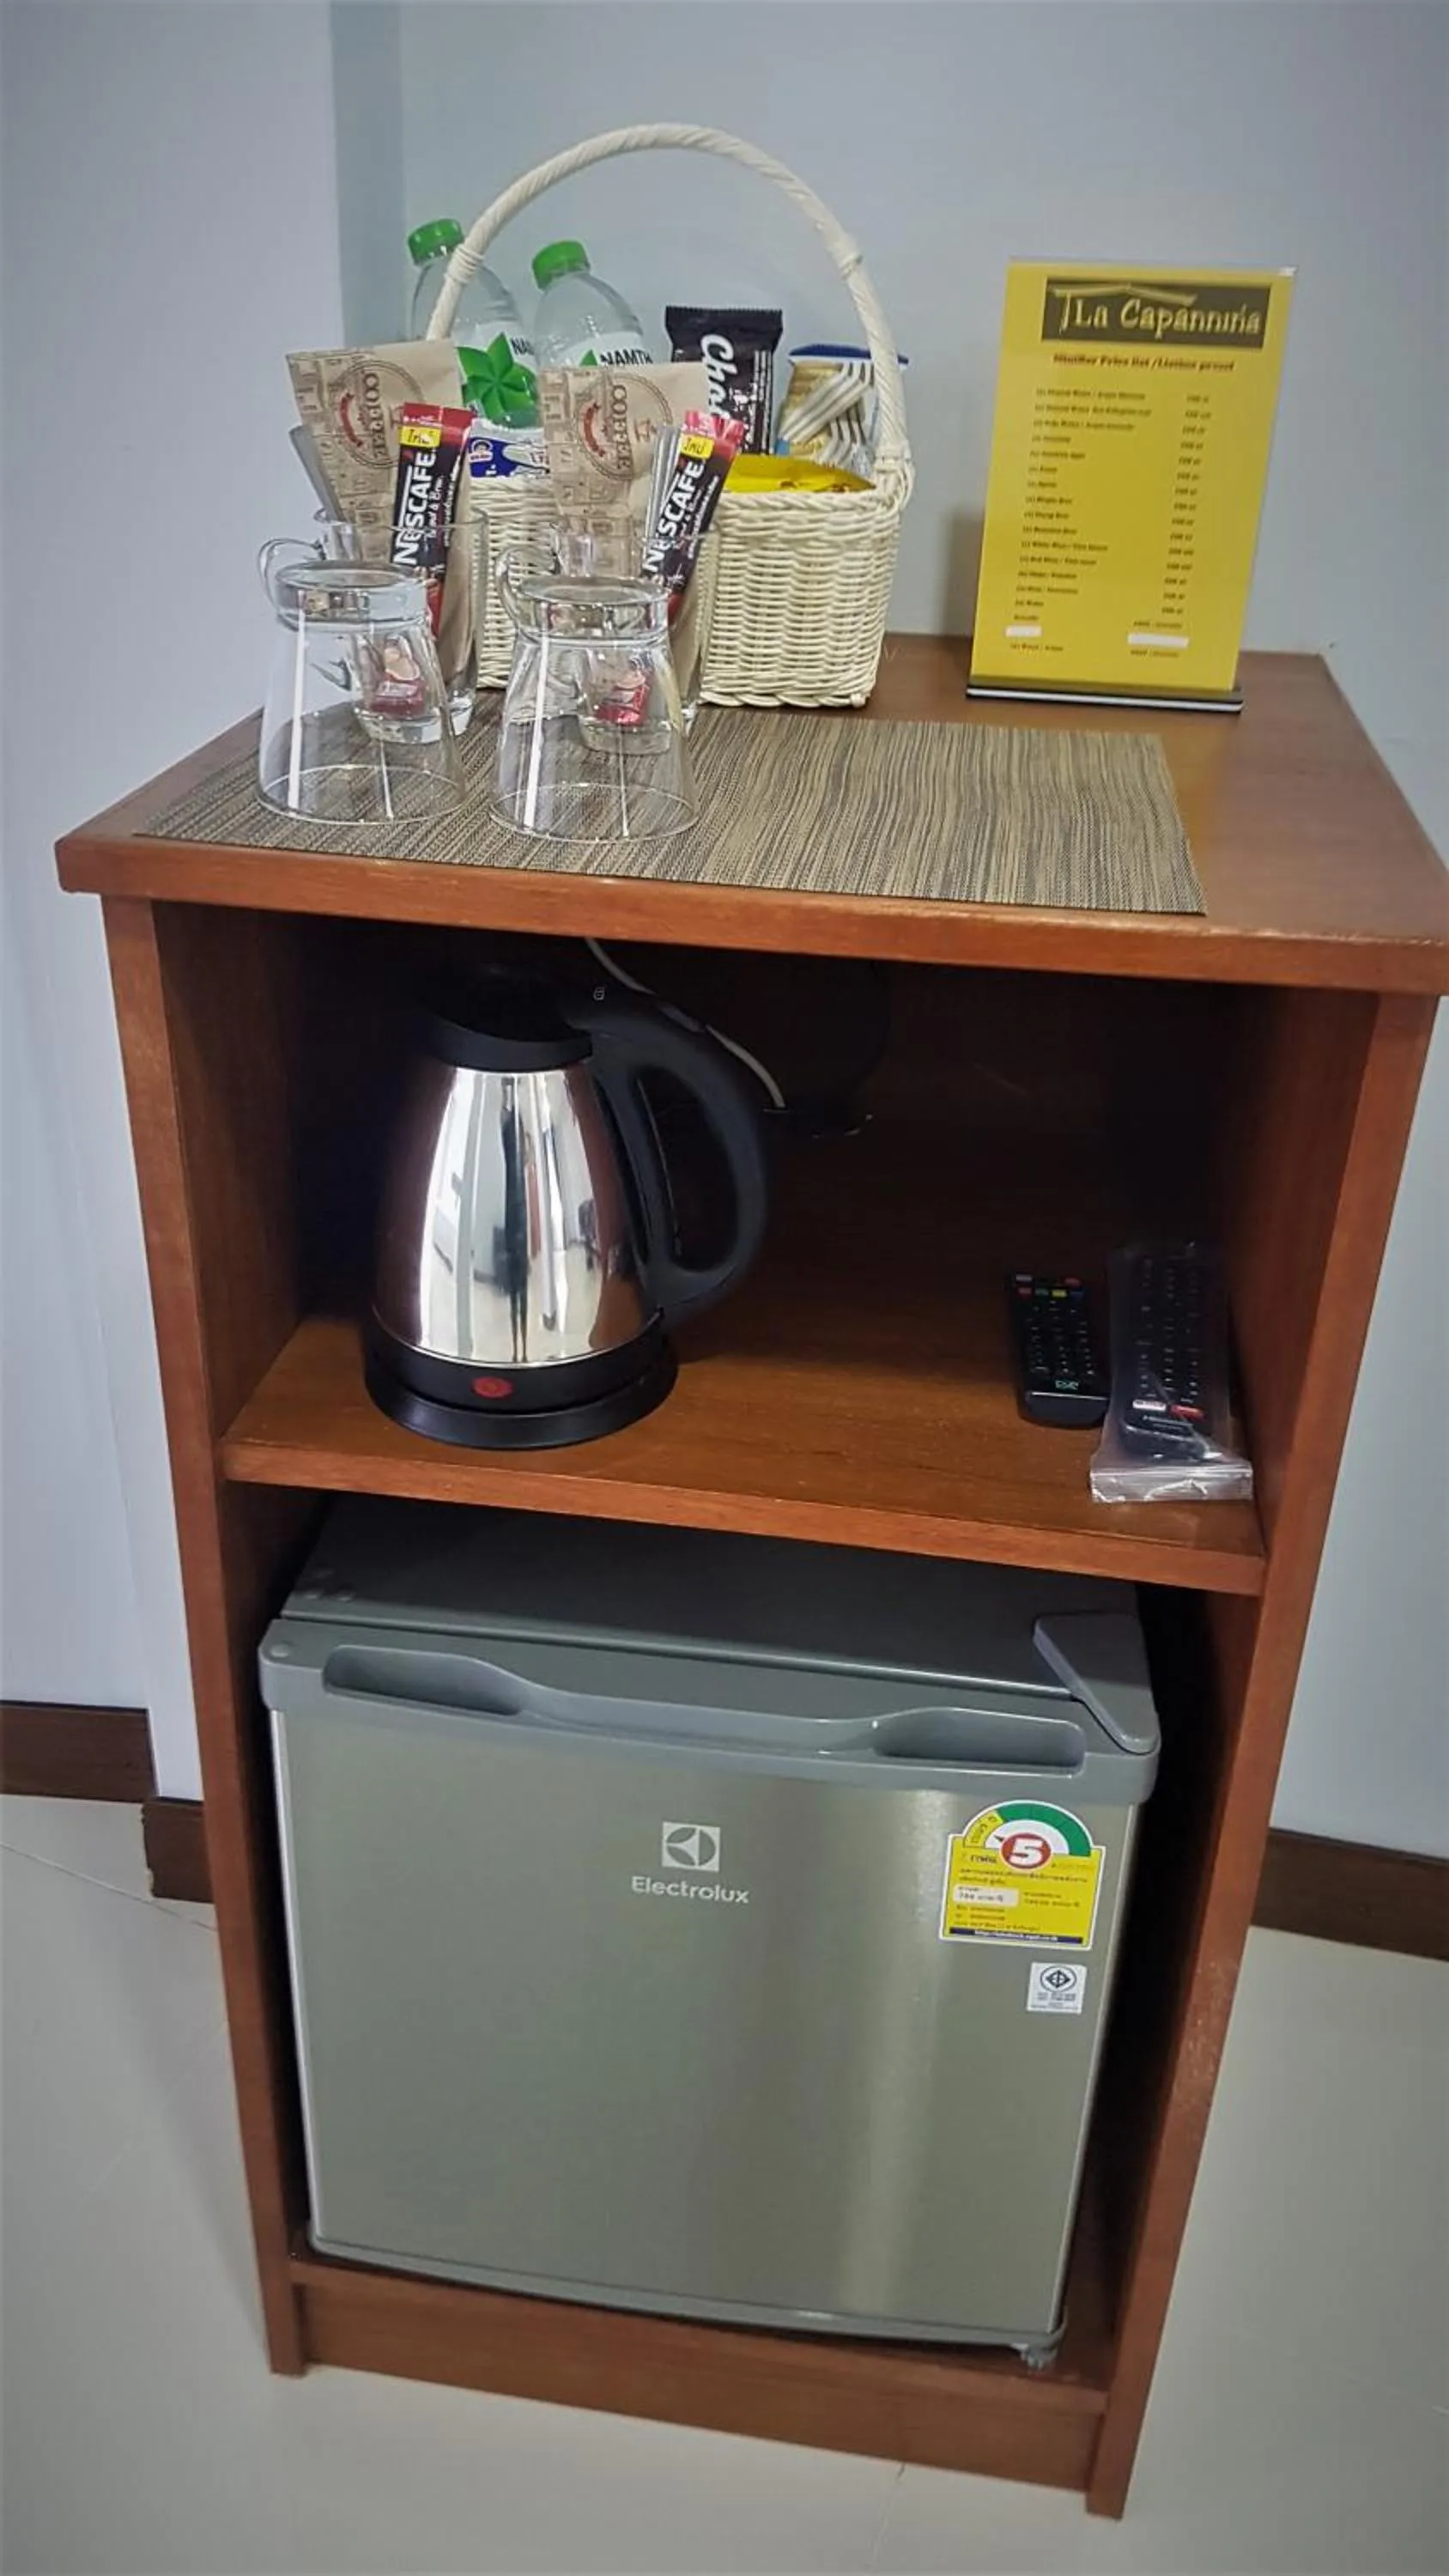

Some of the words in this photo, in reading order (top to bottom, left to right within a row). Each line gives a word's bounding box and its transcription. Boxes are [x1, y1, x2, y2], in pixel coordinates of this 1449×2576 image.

[1074, 299, 1109, 329] La
[1008, 1837, 1046, 1865] 5
[631, 1874, 750, 1905] Electrolux
